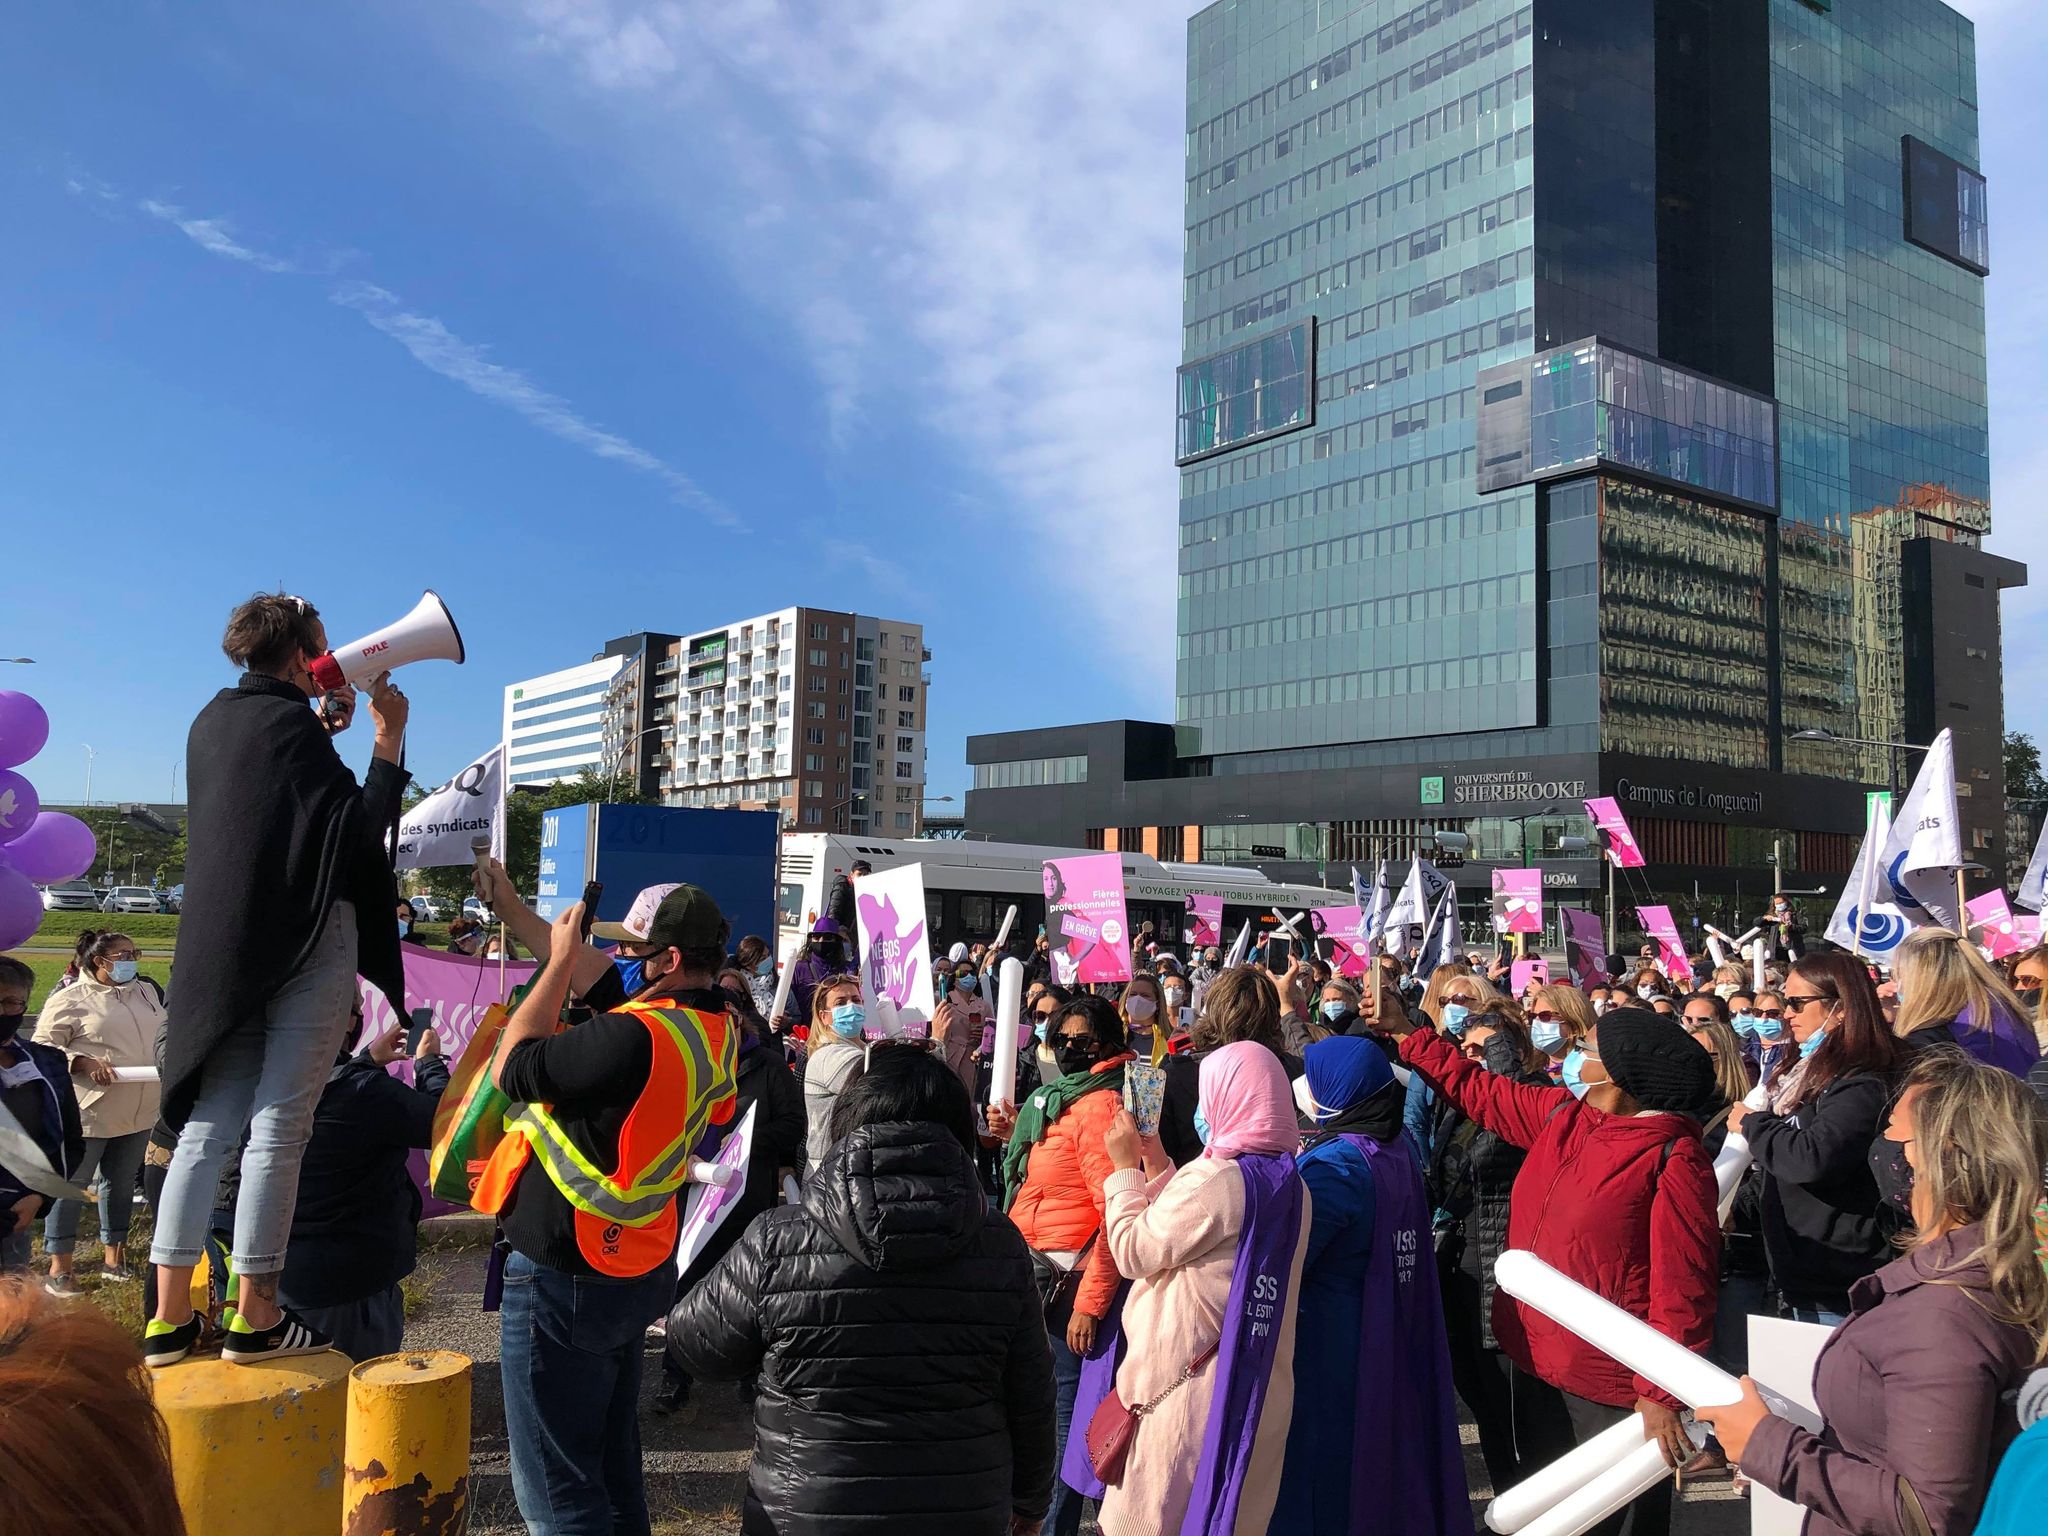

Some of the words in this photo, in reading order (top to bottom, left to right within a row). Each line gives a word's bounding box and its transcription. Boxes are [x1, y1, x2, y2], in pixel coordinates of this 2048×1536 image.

[1454, 770, 1516, 785] UNIVERSITÉ
[1517, 771, 1534, 782] DE
[1454, 781, 1587, 803] SHERBROOKE
[1617, 778, 1675, 808] Campus
[1678, 785, 1695, 806] de
[1698, 787, 1762, 815] Longueuil
[401, 823, 423, 836] des
[427, 818, 490, 837] syndicats
[542, 816, 559, 848] 201
[1092, 889, 1120, 899] Fières
[1139, 886, 1181, 897] VOYAGEZ
[1213, 890, 1254, 901] AUTOBUS
[1049, 899, 1121, 914] professionnelles
[1065, 920, 1075, 932] EN
[1076, 924, 1098, 938] GRÈVE
[871, 937, 900, 961] NÉGOS
